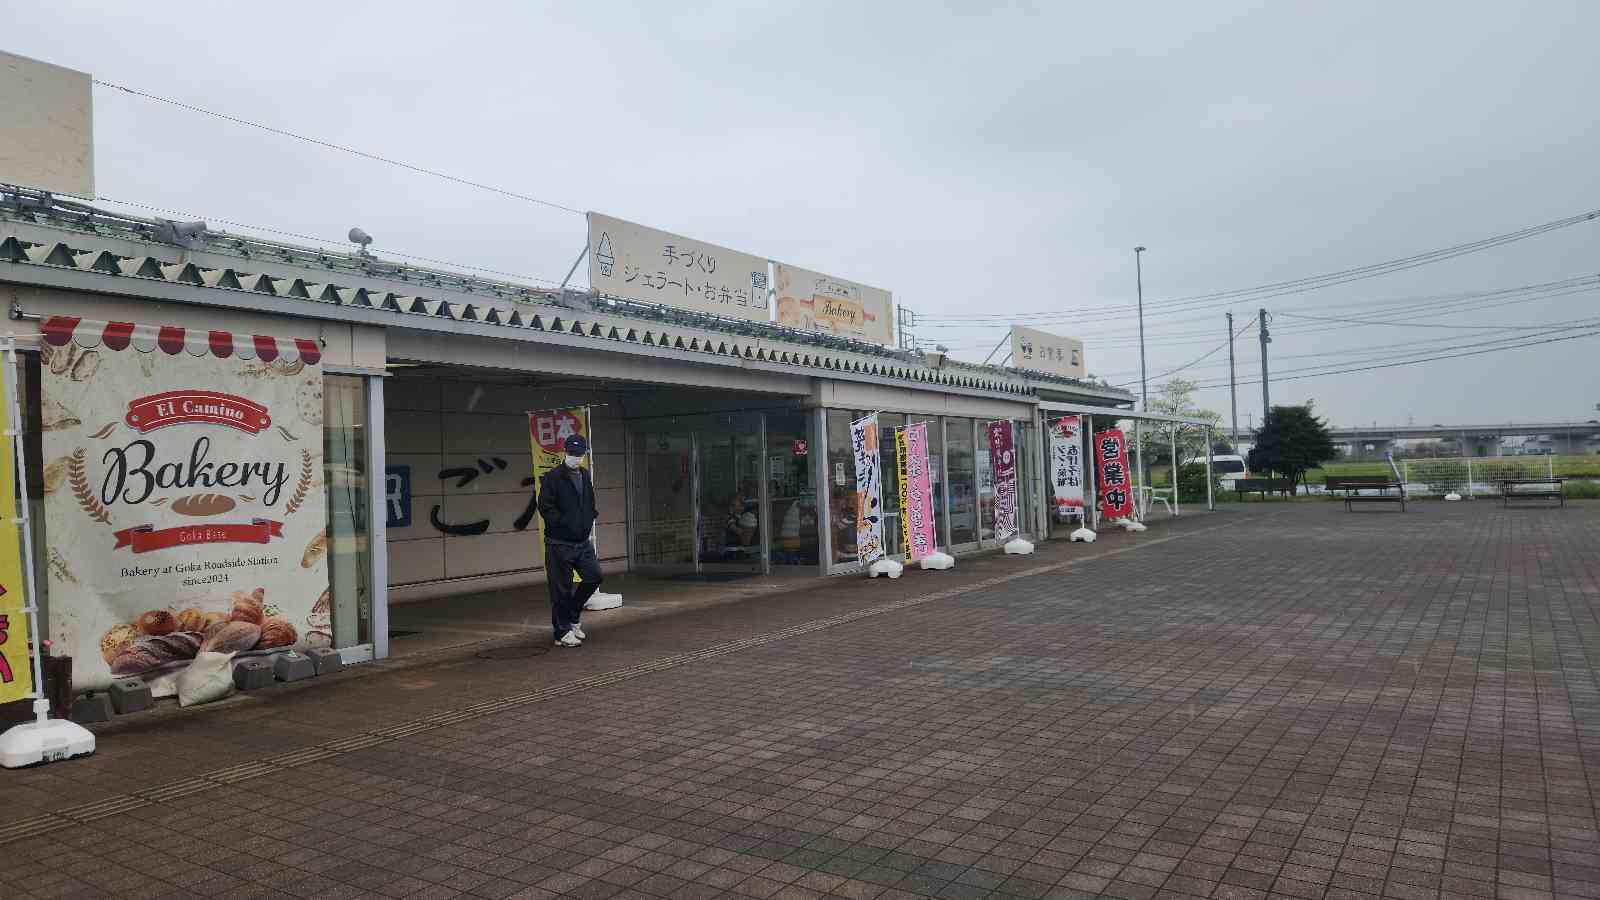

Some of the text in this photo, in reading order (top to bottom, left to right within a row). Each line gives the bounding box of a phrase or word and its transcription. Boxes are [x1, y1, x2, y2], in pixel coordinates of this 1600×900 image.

[663, 245, 717, 274] 手づくり
[624, 265, 748, 307] ジェラート・お弁当
[823, 302, 856, 325] Bakery
[157, 401, 244, 420] El Camino
[536, 415, 576, 446] 日本
[101, 436, 290, 507] Bakery
[1101, 437, 1127, 511] 営業中
[121, 555, 280, 578] Bakery at Goka Roadside Station
